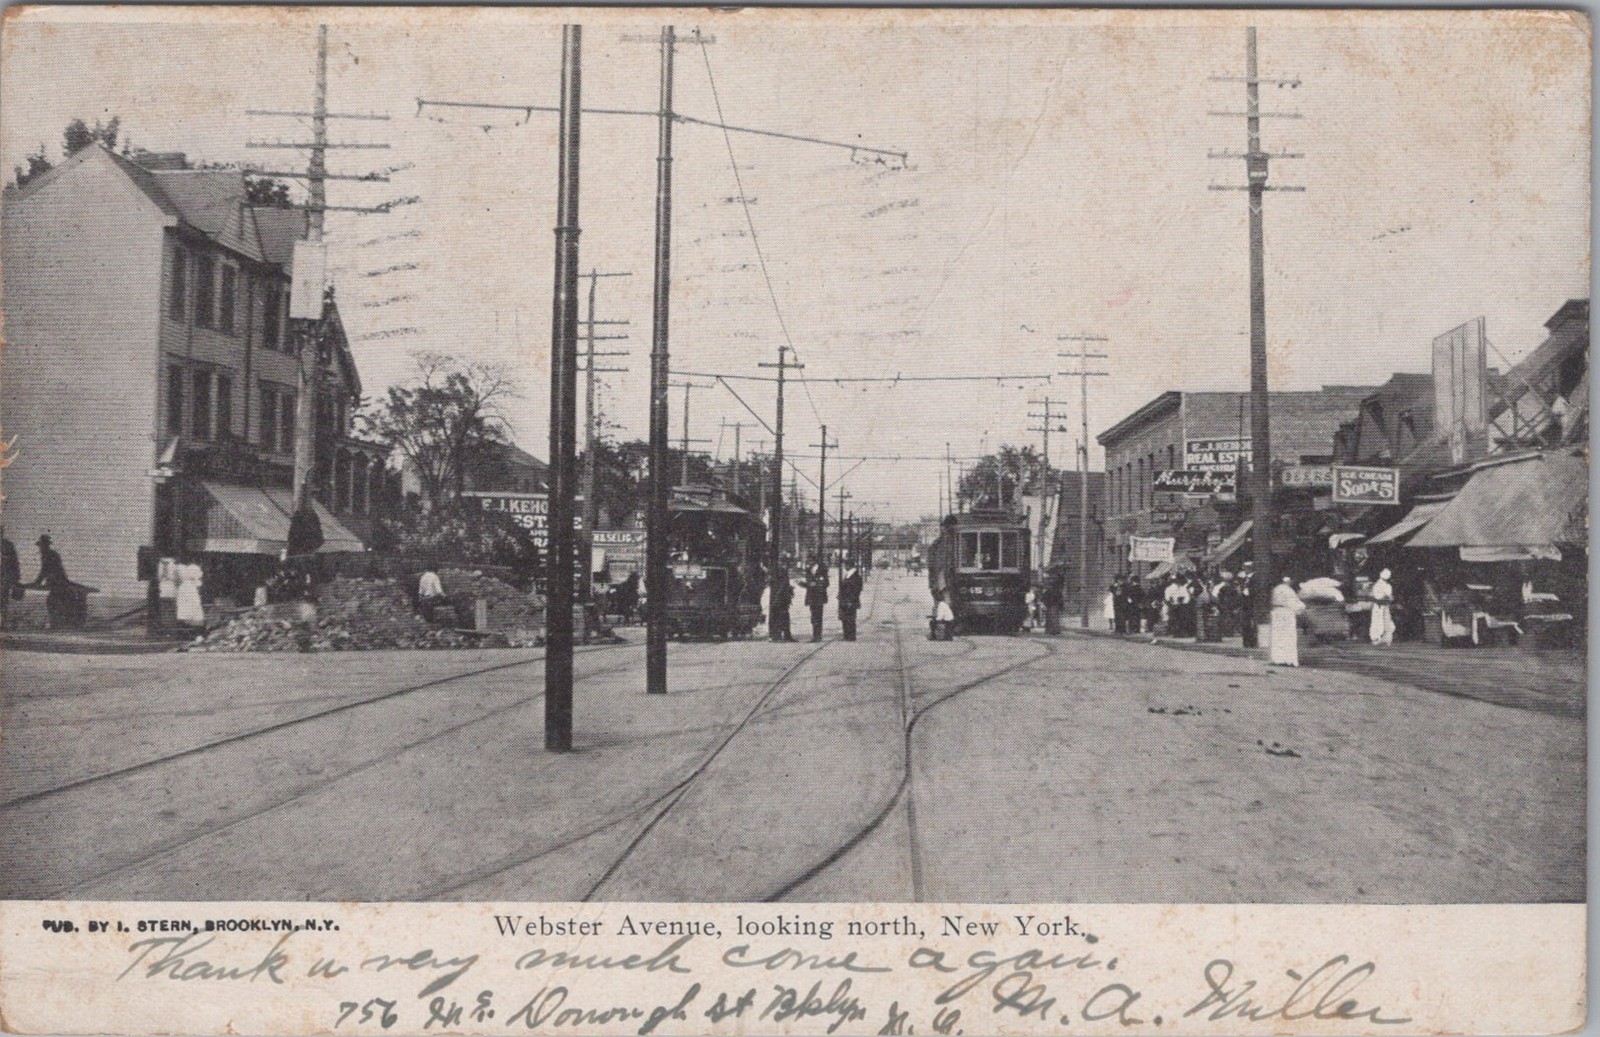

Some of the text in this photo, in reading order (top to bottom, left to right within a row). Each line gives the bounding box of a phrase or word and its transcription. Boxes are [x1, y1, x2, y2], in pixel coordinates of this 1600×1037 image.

[1187, 453, 1216, 464] REAL
[509, 499, 549, 514] KEHO
[115, 928, 302, 984] Thank
[514, 934, 692, 974] much
[334, 998, 399, 1029] 756
